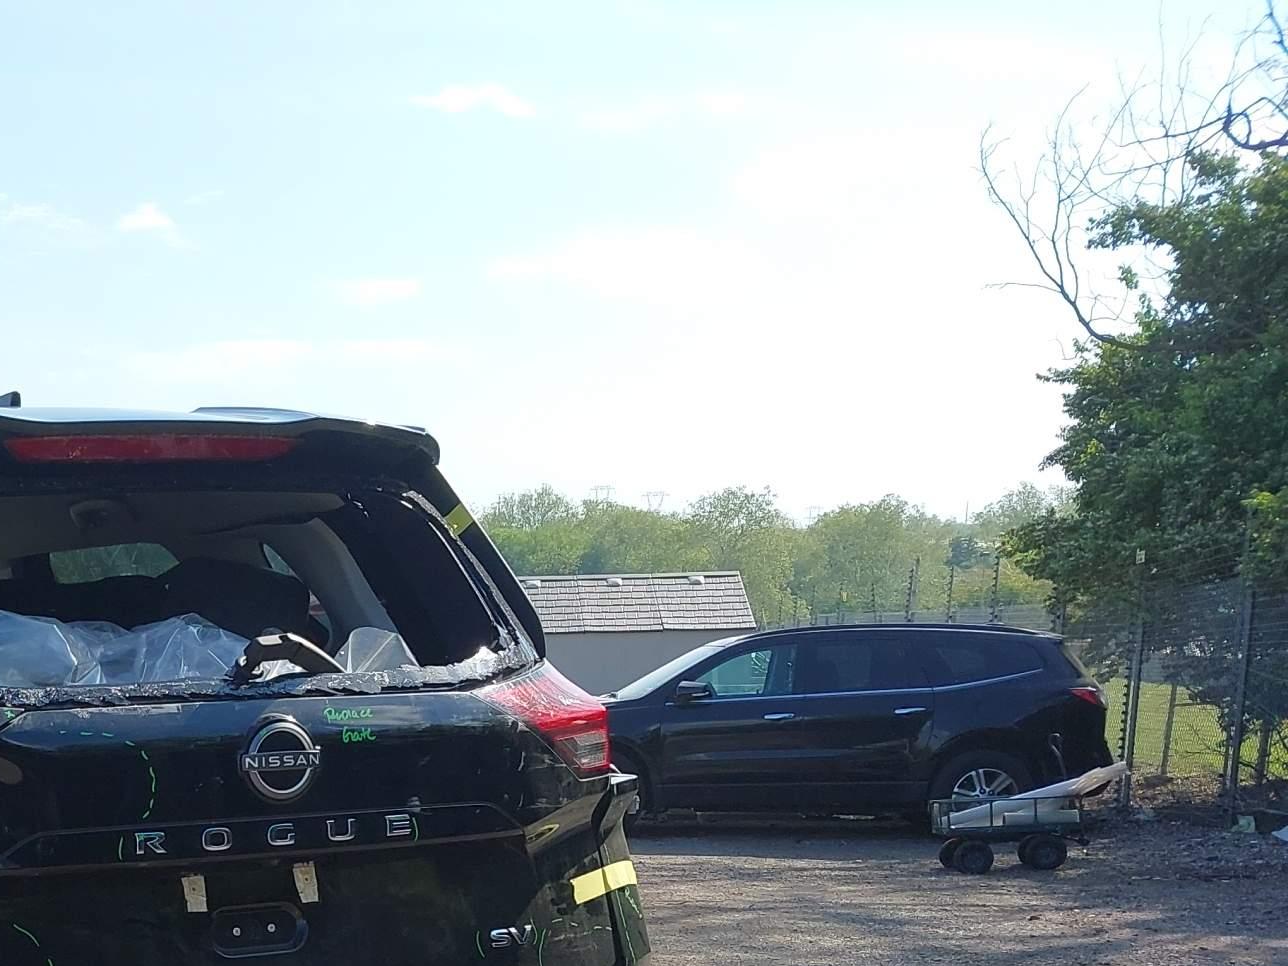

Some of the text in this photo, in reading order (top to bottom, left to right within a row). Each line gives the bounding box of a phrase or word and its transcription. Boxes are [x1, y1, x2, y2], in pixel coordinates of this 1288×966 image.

[244, 753, 320, 769] NISSAN
[133, 813, 413, 855] ROGUE
[490, 924, 532, 949] SV
